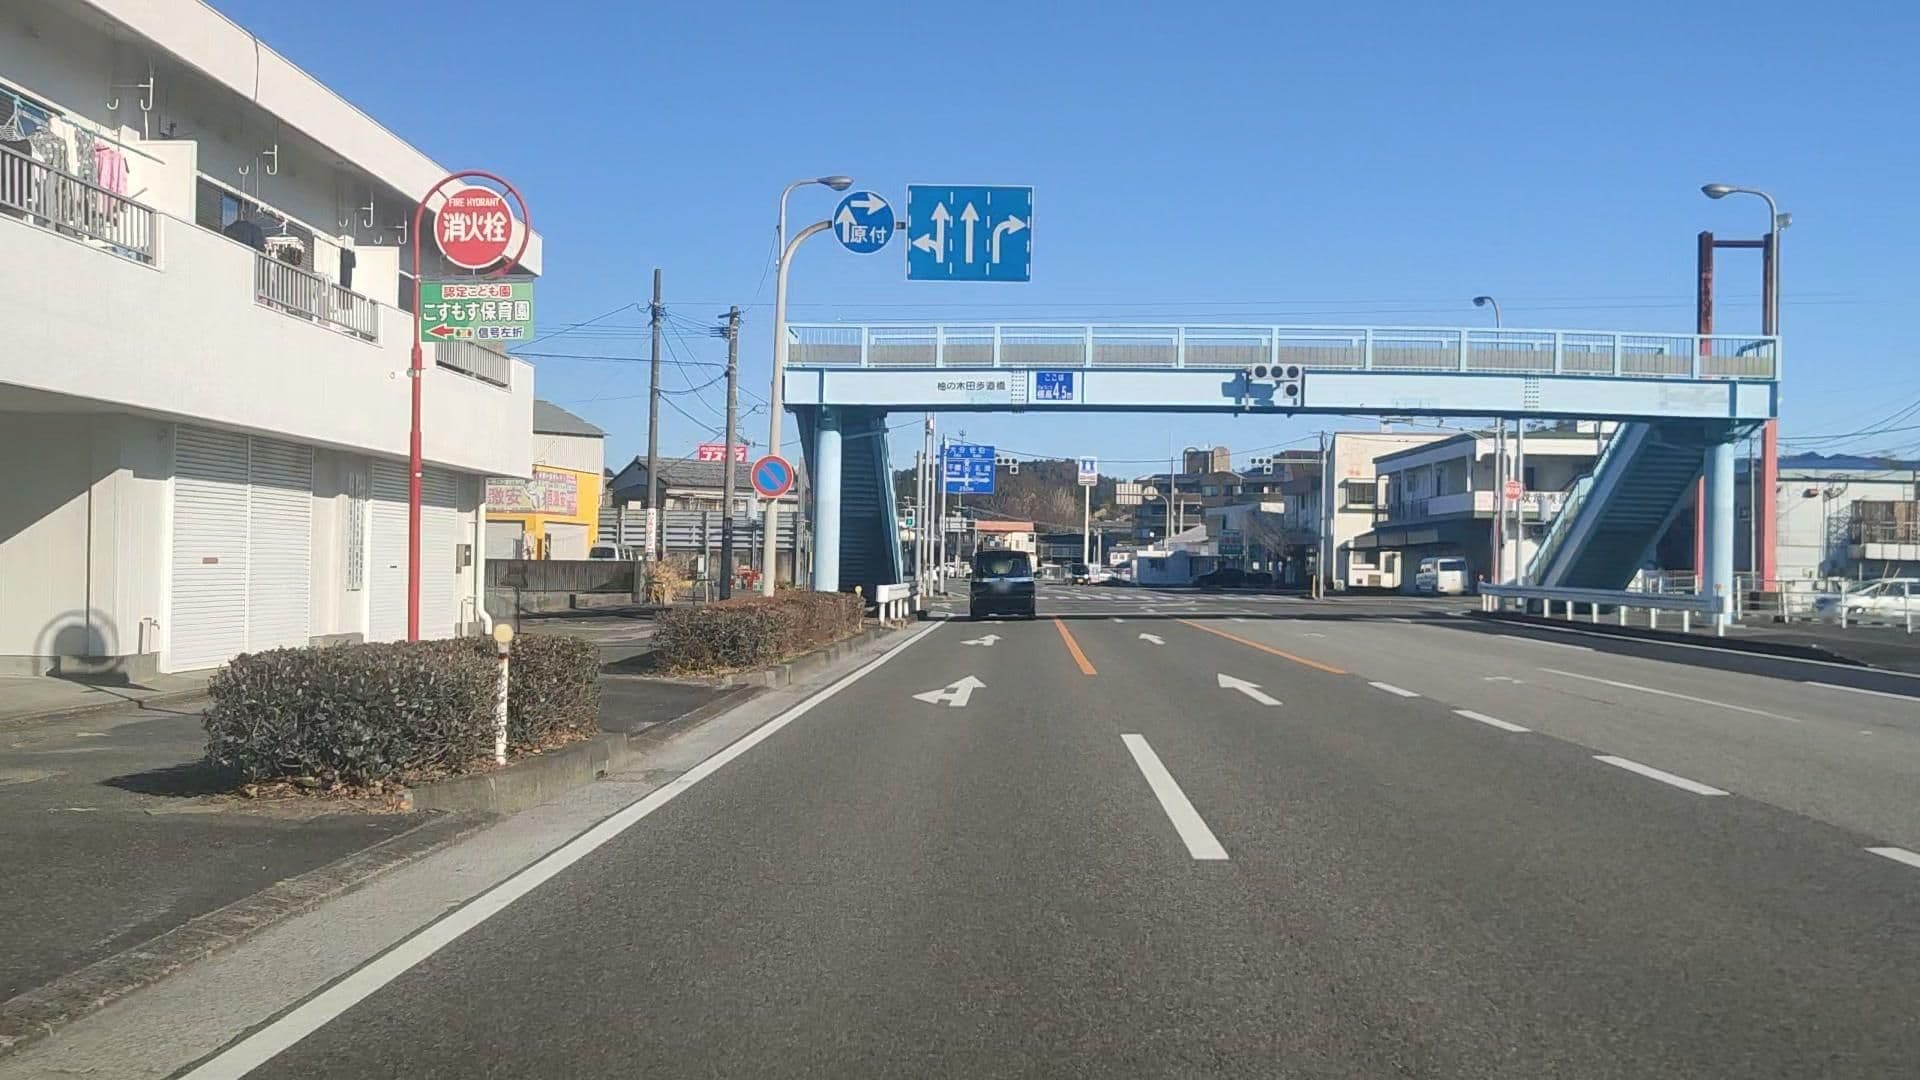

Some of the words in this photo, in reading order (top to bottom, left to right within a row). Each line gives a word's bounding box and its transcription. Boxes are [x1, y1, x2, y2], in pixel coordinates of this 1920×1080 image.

[449, 198, 465, 207] FIRE
[467, 198, 499, 207] HYDRANT
[443, 211, 508, 243] 消火栓
[850, 225, 888, 244] 原付
[443, 285, 511, 299] 認定こども園
[423, 300, 531, 322] こすもす保育園
[478, 327, 523, 339] 信号左折
[700, 451, 745, 461] コスス
